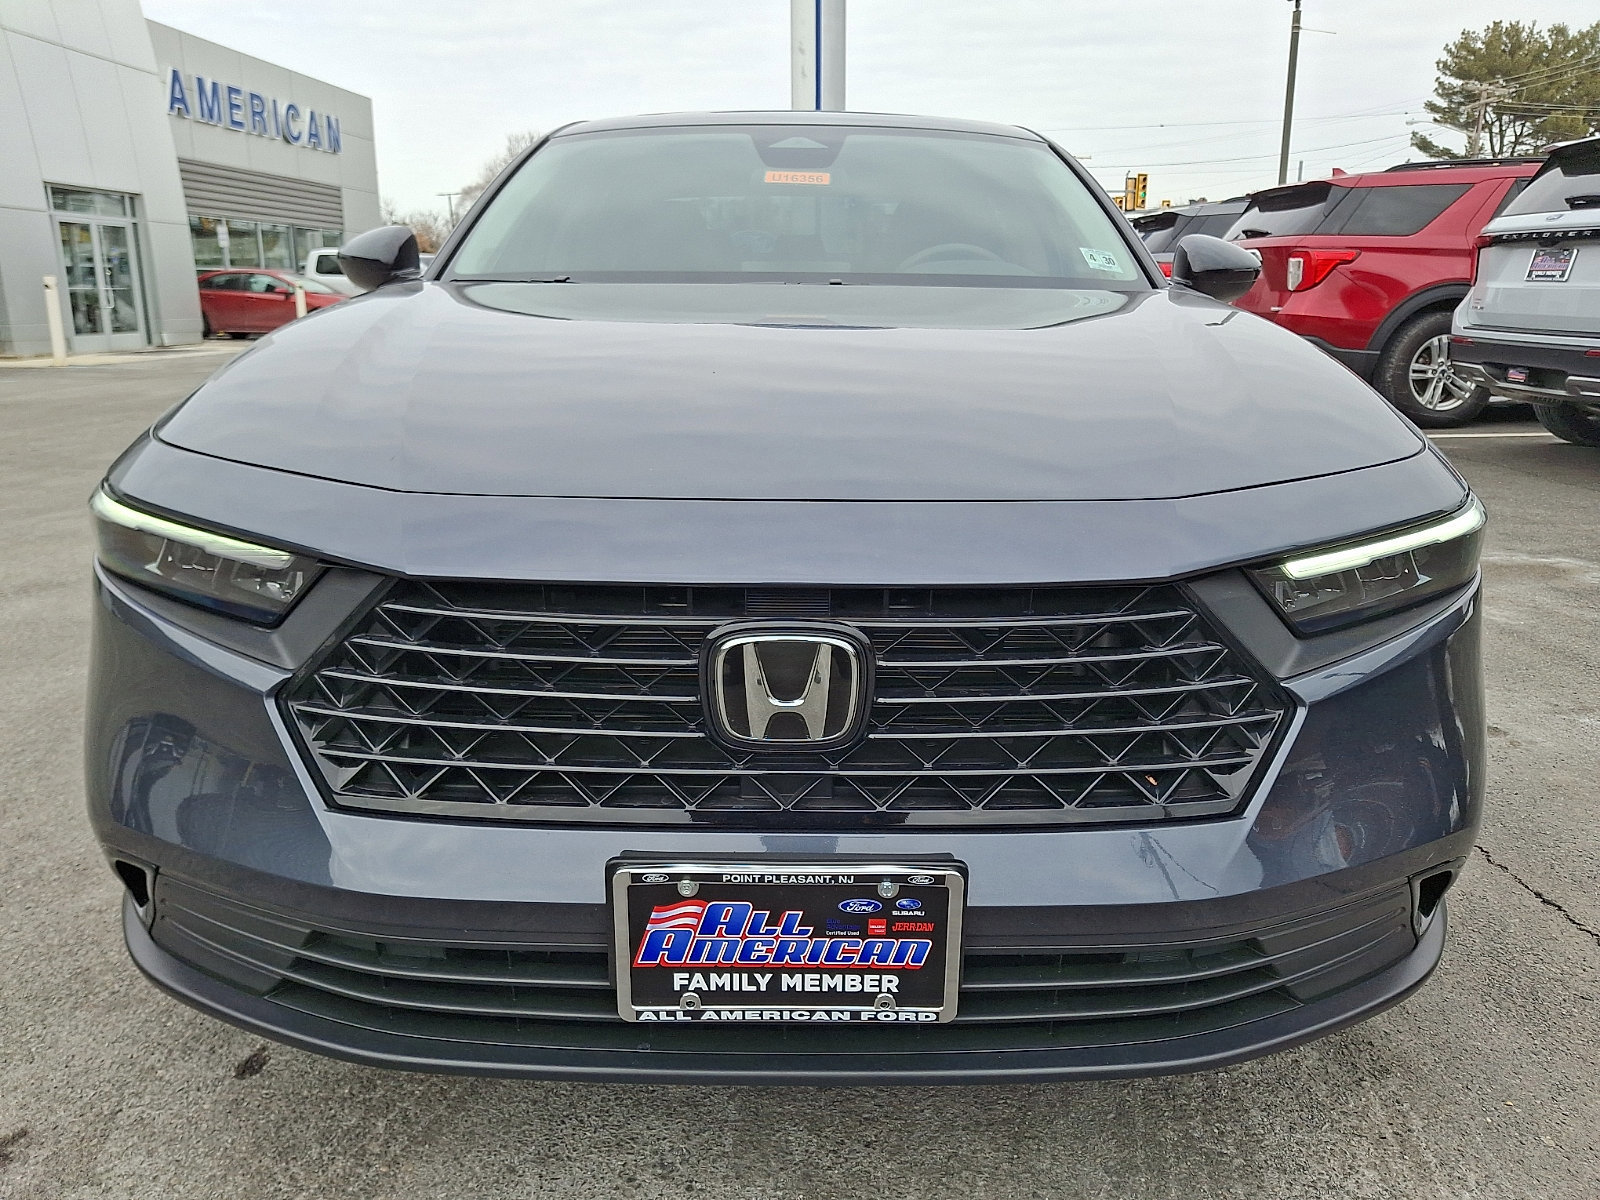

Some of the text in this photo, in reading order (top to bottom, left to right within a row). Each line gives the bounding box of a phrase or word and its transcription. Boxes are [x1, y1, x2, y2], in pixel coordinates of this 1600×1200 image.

[169, 66, 343, 155] AMERICAN
[1502, 230, 1593, 240] EXPLORER
[722, 874, 854, 885] POINT PLEASANT, NJ
[843, 901, 877, 912] Ford
[696, 901, 814, 938] ALL
[634, 928, 932, 968] AMERICAN
[673, 973, 899, 993] FAMILY MEMBER
[638, 1011, 938, 1021] ALL AMERICAN FORD
